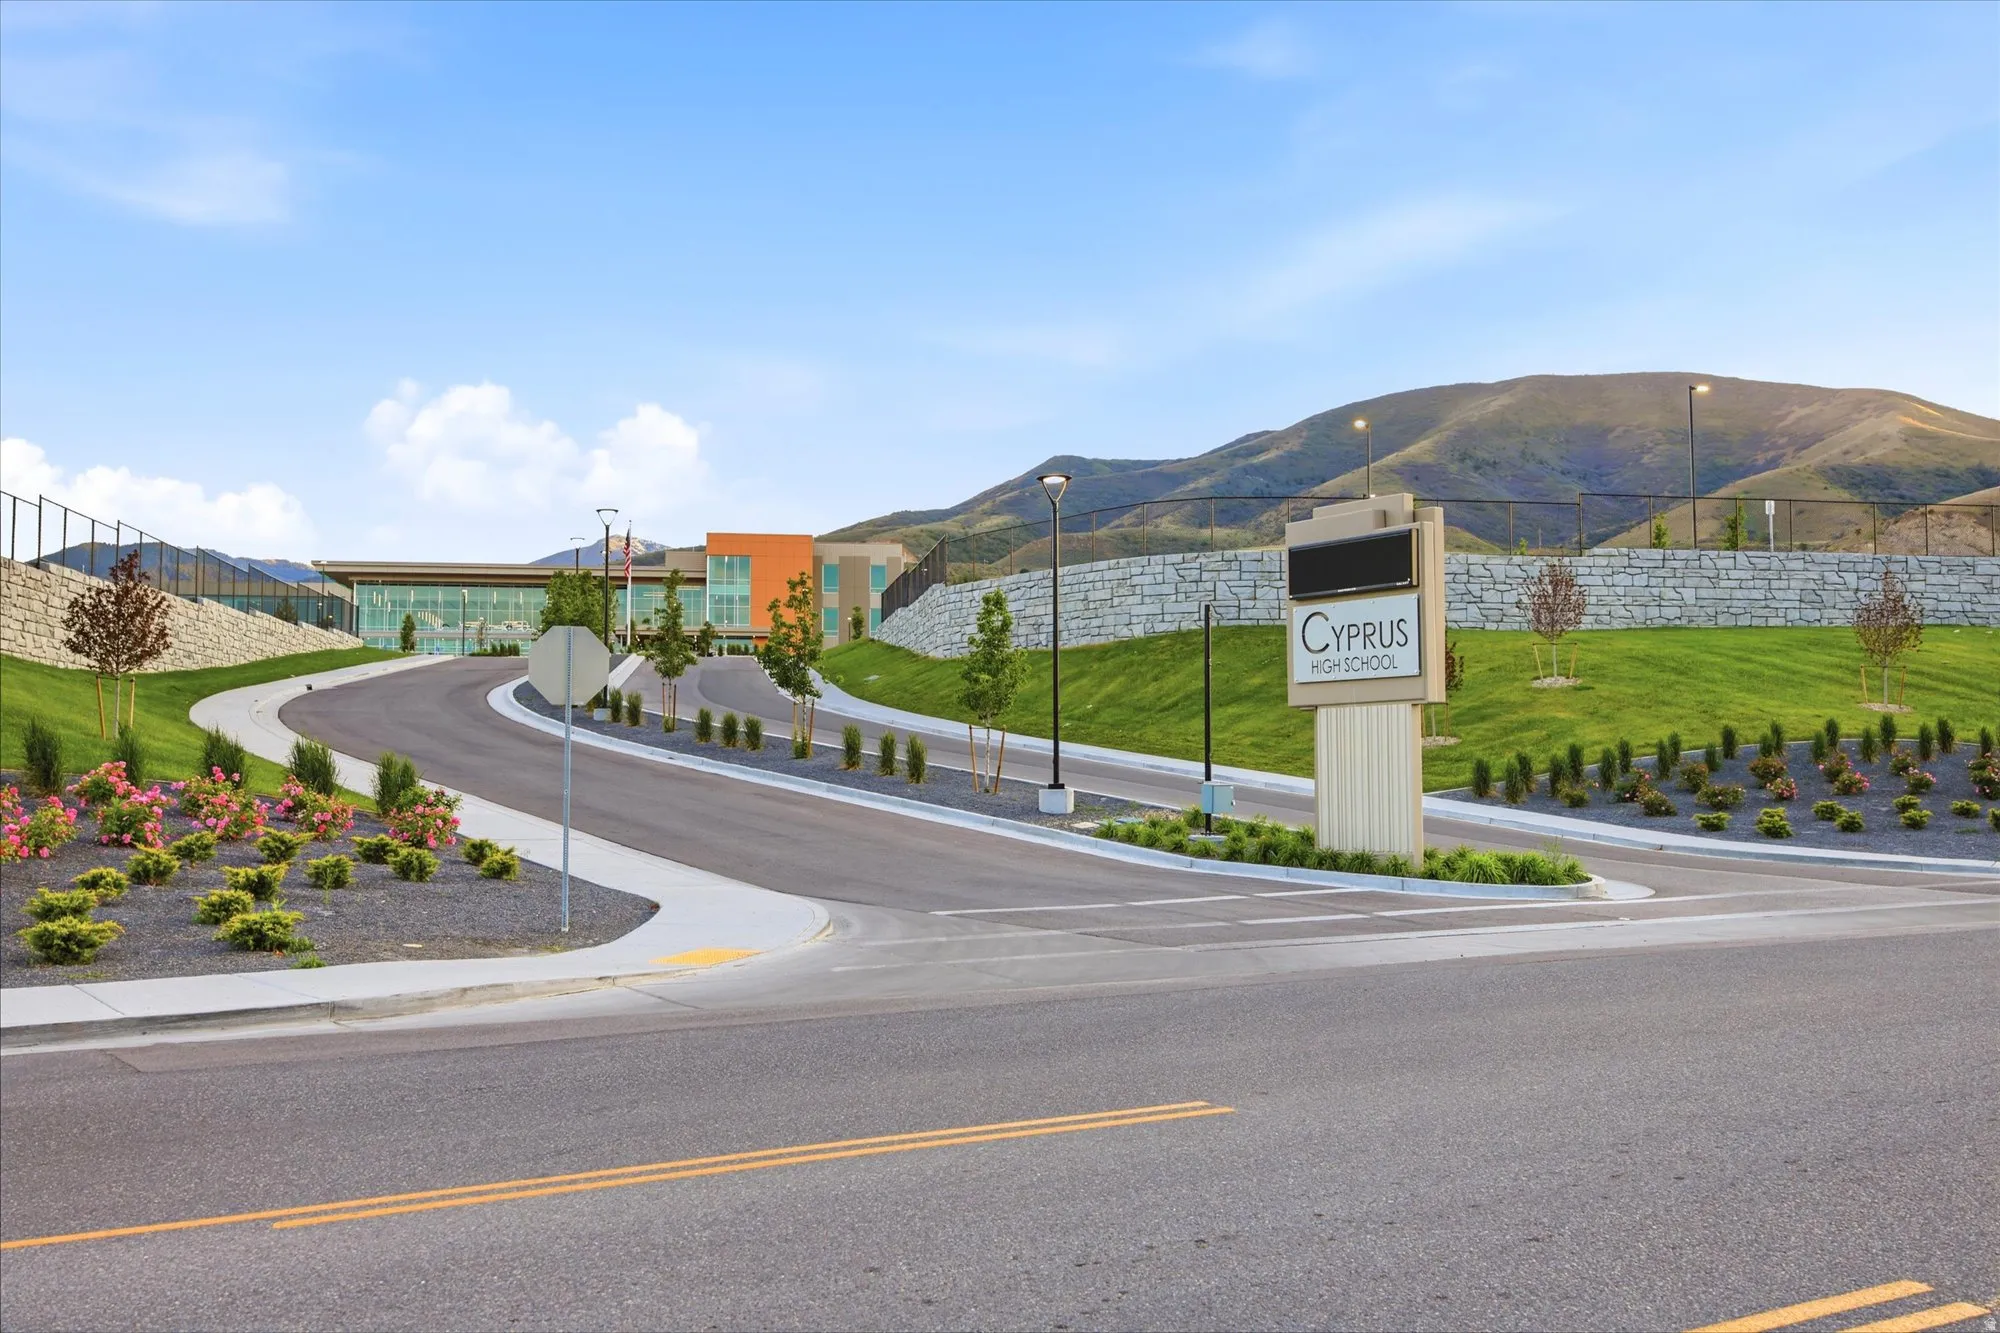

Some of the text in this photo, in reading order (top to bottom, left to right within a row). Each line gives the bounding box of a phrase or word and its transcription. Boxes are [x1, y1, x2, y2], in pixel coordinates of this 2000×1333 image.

[1302, 611, 1408, 654] CYPRUS
[1311, 654, 1398, 675] HIGH SCHOOL
